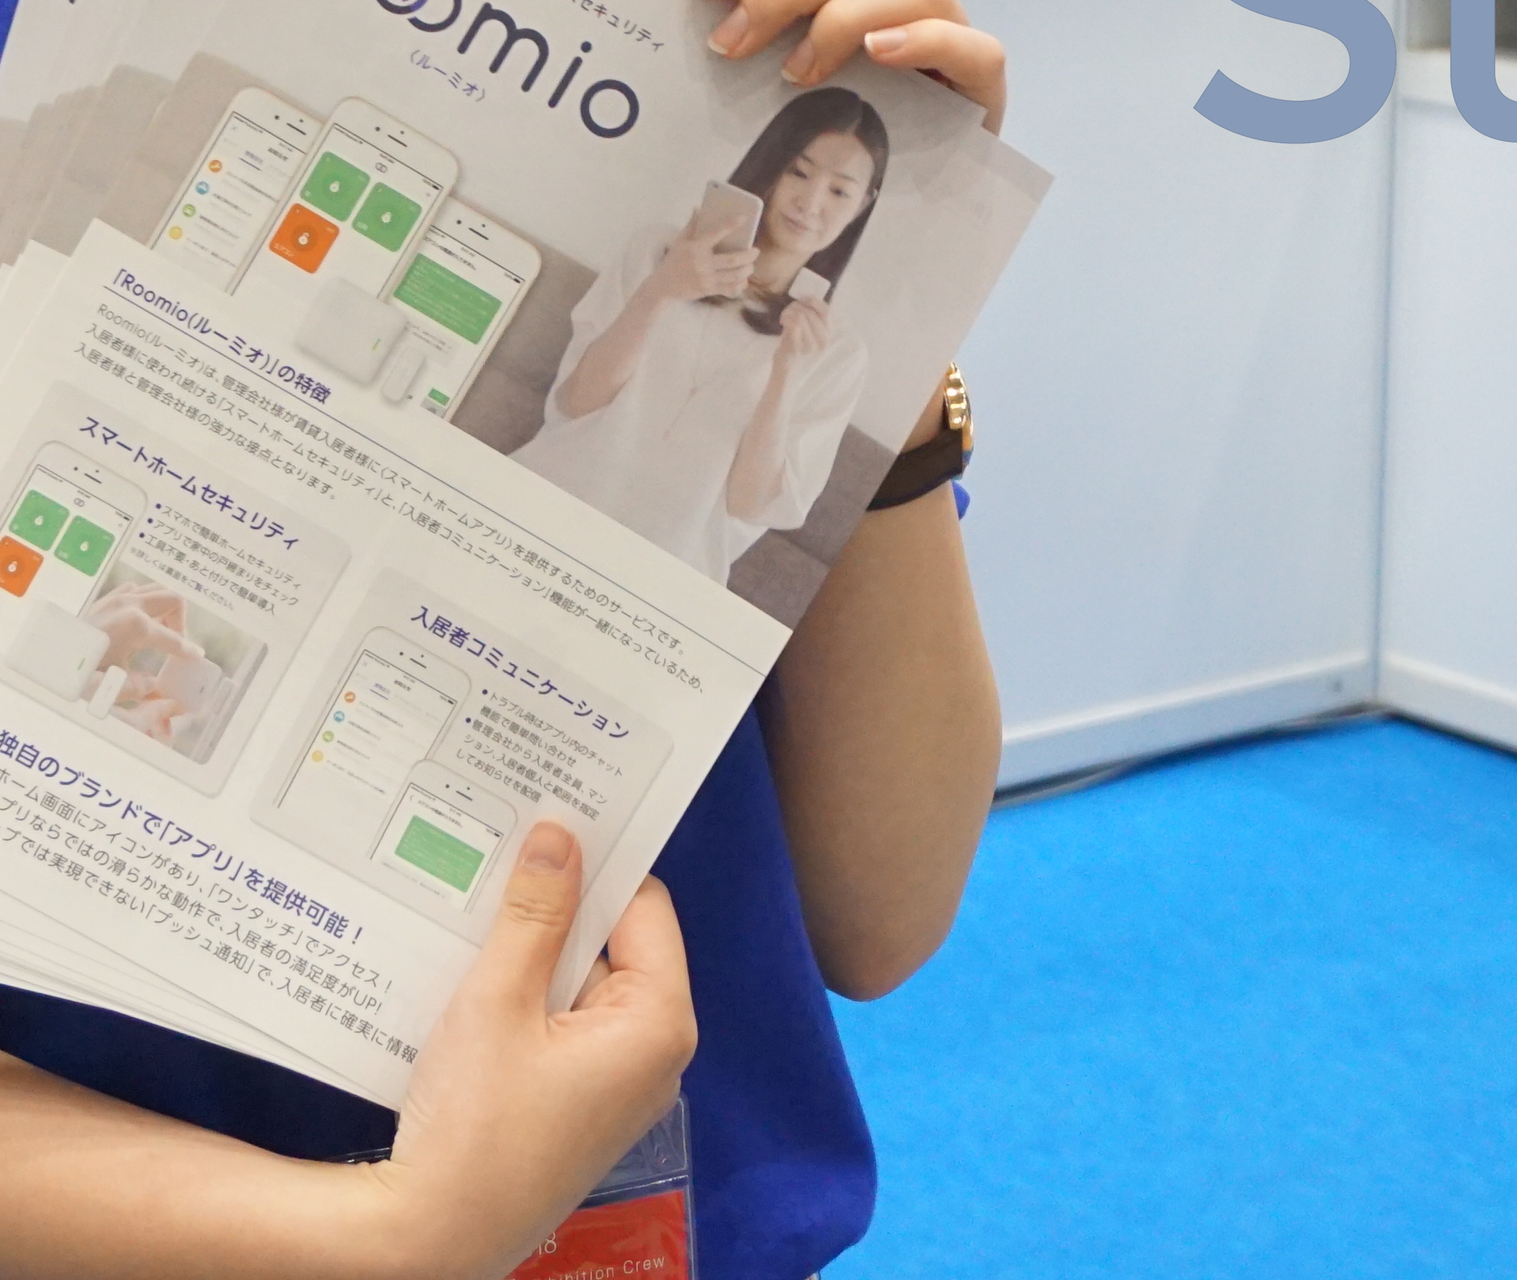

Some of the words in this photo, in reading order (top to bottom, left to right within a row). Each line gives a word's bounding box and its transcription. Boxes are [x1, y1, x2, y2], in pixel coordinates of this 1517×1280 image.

[74, 343, 334, 499] 入居者様と管理会社様の強力な接点となります。
[80, 417, 298, 549] スマートホームセキュリティ
[161, 506, 301, 589] スマホで簡単ホームセキュリティ
[411, 606, 629, 738] 入居者コミュニケーション
[480, 705, 576, 767] 機能で簡単問い合わせ
[490, 692, 622, 776] トラブル時はアプリ内のチャット
[457, 749, 541, 803] してお知らせを配信
[622, 1256, 665, 1274] Crew
